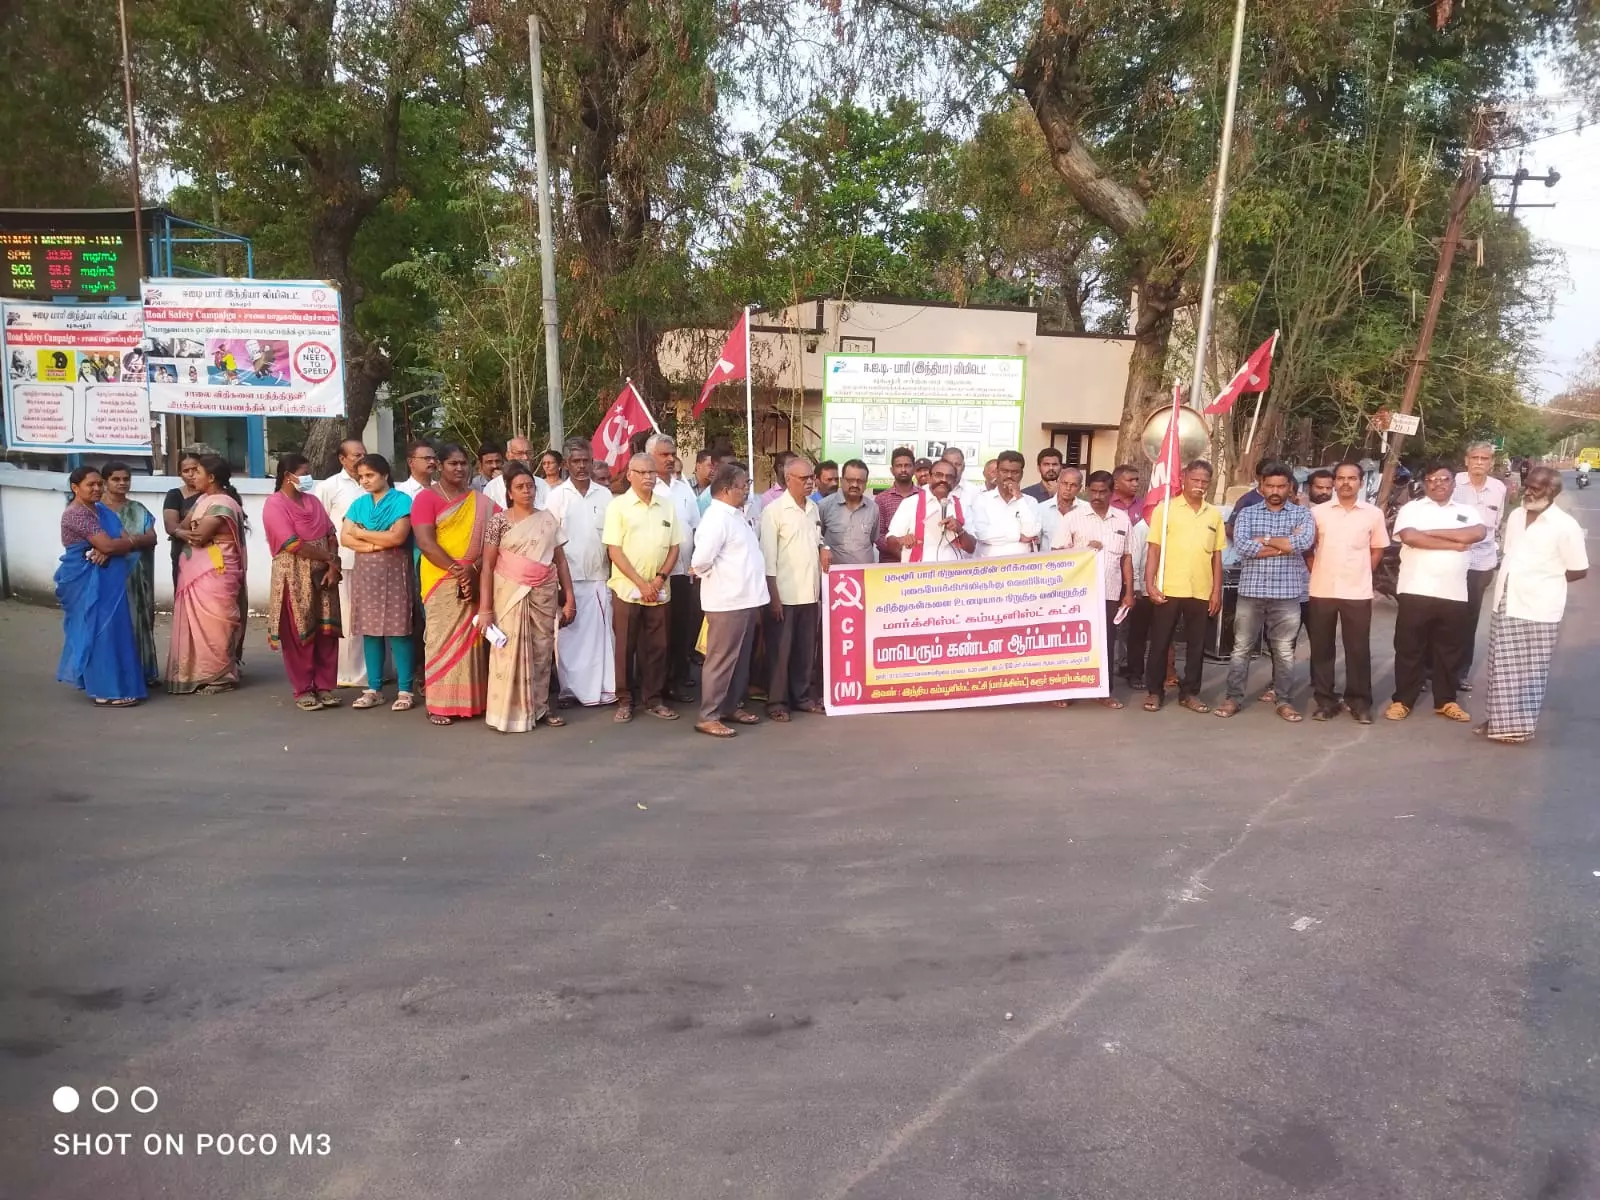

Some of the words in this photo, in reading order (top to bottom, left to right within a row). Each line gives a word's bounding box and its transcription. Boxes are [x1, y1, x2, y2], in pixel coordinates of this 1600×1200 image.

[11, 264, 33, 276] SO2
[13, 279, 36, 290] NOX
[146, 310, 166, 320] Road
[168, 309, 193, 321] Safety
[194, 310, 236, 322] Campaign
[44, 333, 76, 346] Campaign
[306, 346, 322, 354] NO
[303, 353, 327, 361] NEED
[303, 367, 329, 375] SPEED
[893, 361, 911, 374] பாரி
[882, 614, 961, 630] மார்க்சிஸ்ட்
[965, 607, 1044, 626] கம்யூனிஸ்ட்
[1048, 604, 1081, 617] கட்சி
[877, 635, 943, 664] மாபெரும்
[946, 633, 1003, 658] கண்டன
[1007, 623, 1088, 657] ஆர்ப்பாட்டம்
[902, 683, 929, 698] இந்திய
[929, 681, 971, 697] கம்யூனிஸ்ட்
[971, 679, 987, 692] கட்சி
